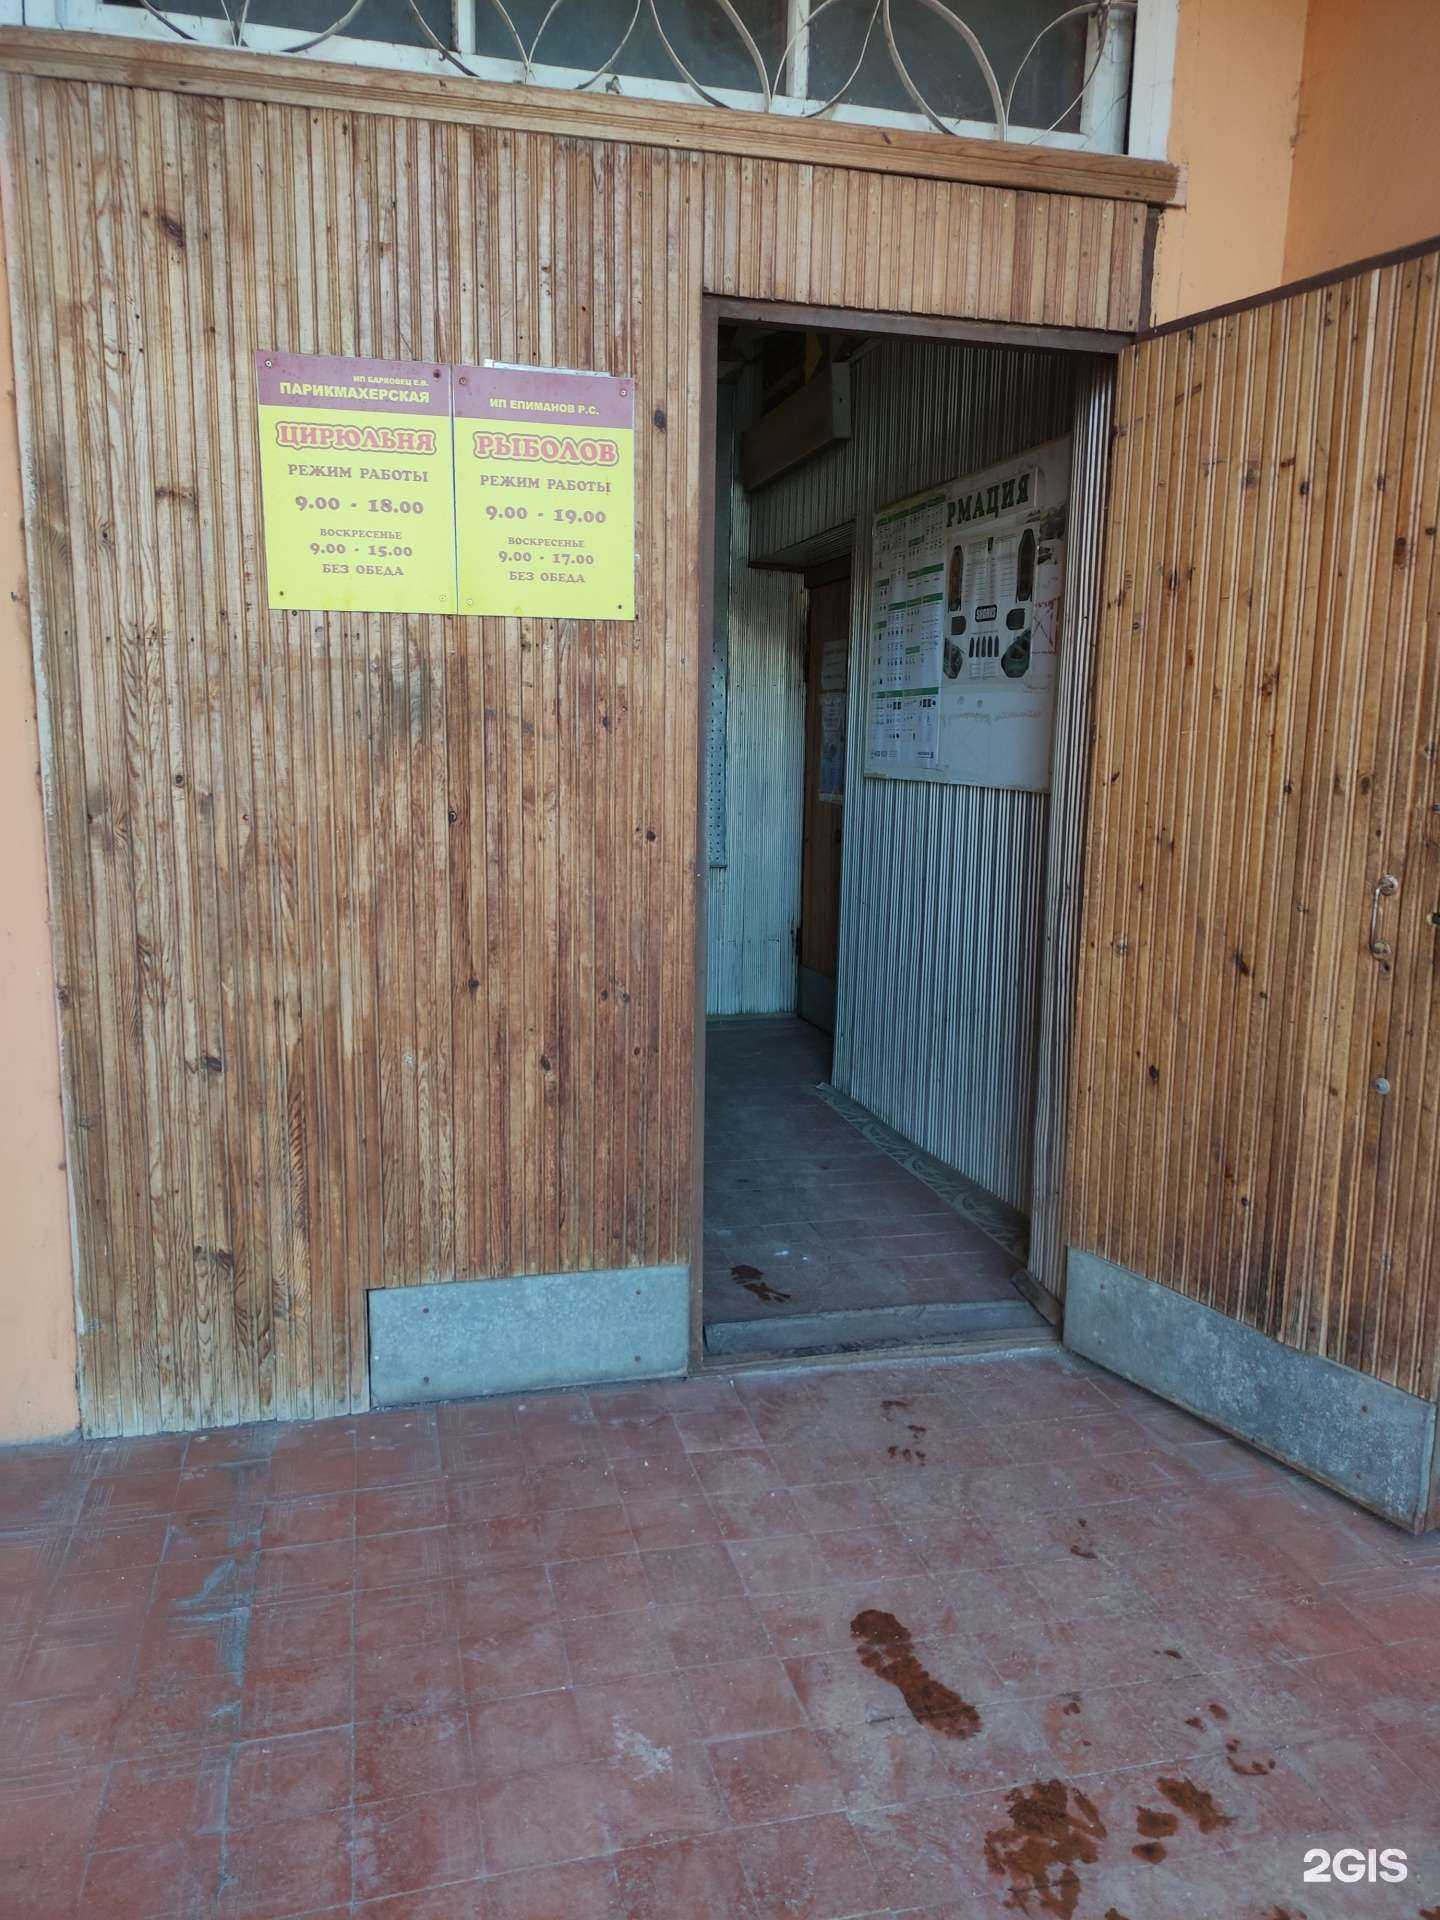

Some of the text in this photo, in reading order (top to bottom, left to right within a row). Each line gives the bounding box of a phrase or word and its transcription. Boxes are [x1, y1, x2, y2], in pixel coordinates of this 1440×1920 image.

[280, 382, 429, 403] ПАРИКМАХЕРСКАЯ
[490, 398, 599, 415] ИП ЕПИМАНОВ Р.С.
[278, 423, 435, 452] ЦИРЮЛЬНЯ
[475, 433, 618, 465] РЫБОЛОВ
[288, 464, 428, 482] РЕЖИМ РАБОТЫ
[480, 475, 611, 492] РЕЖИМ РАБОТЫ
[295, 496, 340, 511] 9.00
[368, 499, 424, 514] 18.00
[486, 506, 528, 520] 9.00
[554, 509, 606, 524] 19.00
[320, 528, 402, 539] ВОСКРЕСЕНЬЕ
[508, 537, 584, 547] ВОСКРЕСЕНЬЕ
[310, 543, 345, 554] 9.00
[368, 545, 412, 557] 15.00
[498, 551, 532, 562] 9.00
[552, 553, 593, 565] 17.00
[323, 564, 404, 575] БЕЗ ОБЕДА
[509, 572, 585, 583] БЕЗ ОБЕДА
